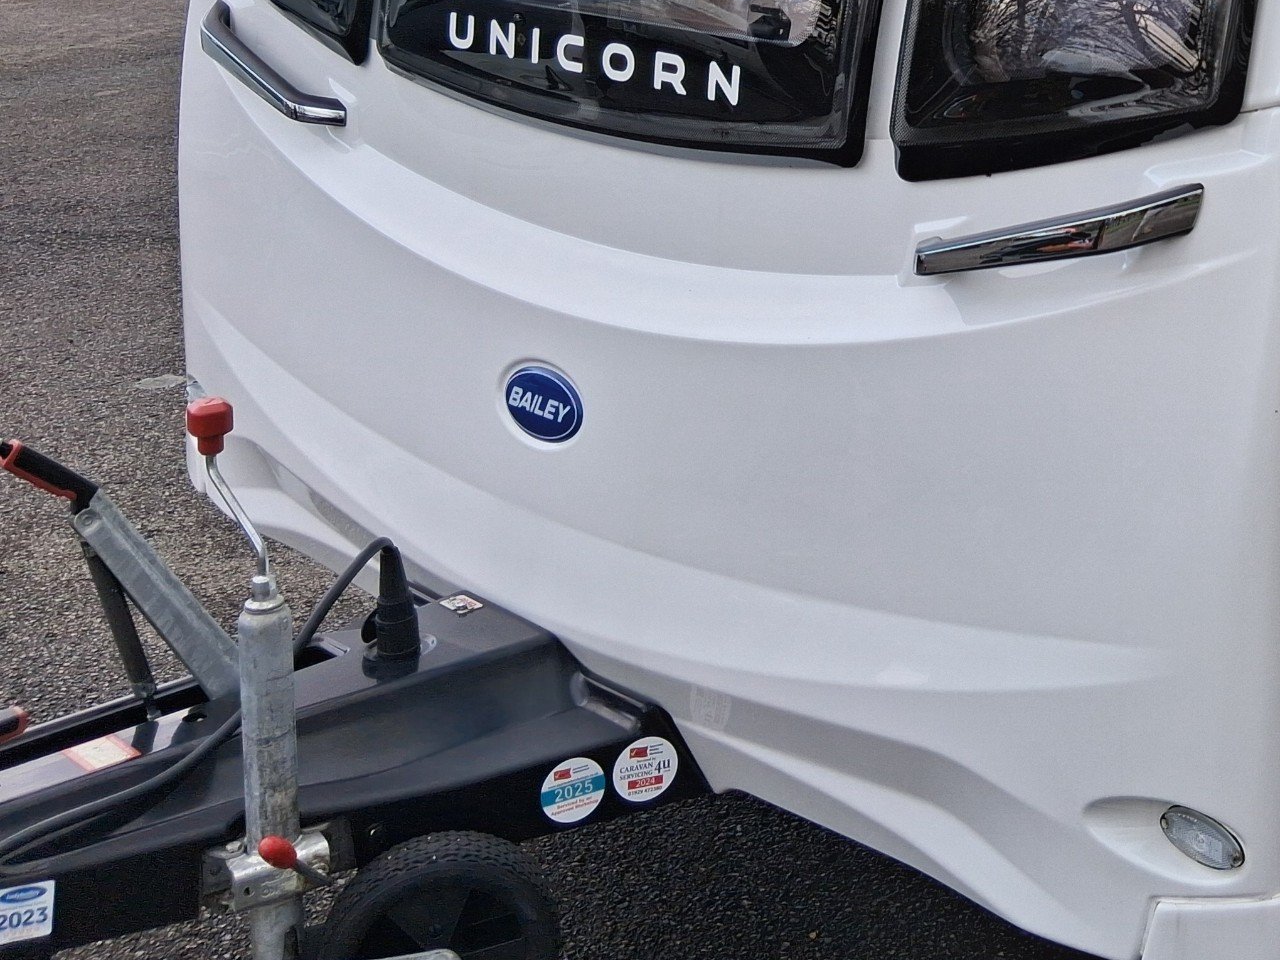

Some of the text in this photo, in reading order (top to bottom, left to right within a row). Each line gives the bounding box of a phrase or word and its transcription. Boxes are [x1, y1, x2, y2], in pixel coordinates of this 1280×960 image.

[449, 12, 740, 106] UNICORN
[508, 386, 571, 423] BAILEY
[619, 762, 654, 774] CARAVAN
[619, 769, 653, 781] SERVICING
[554, 779, 593, 803] 2025
[635, 778, 656, 788] 2024
[0, 906, 48, 930] 2023
